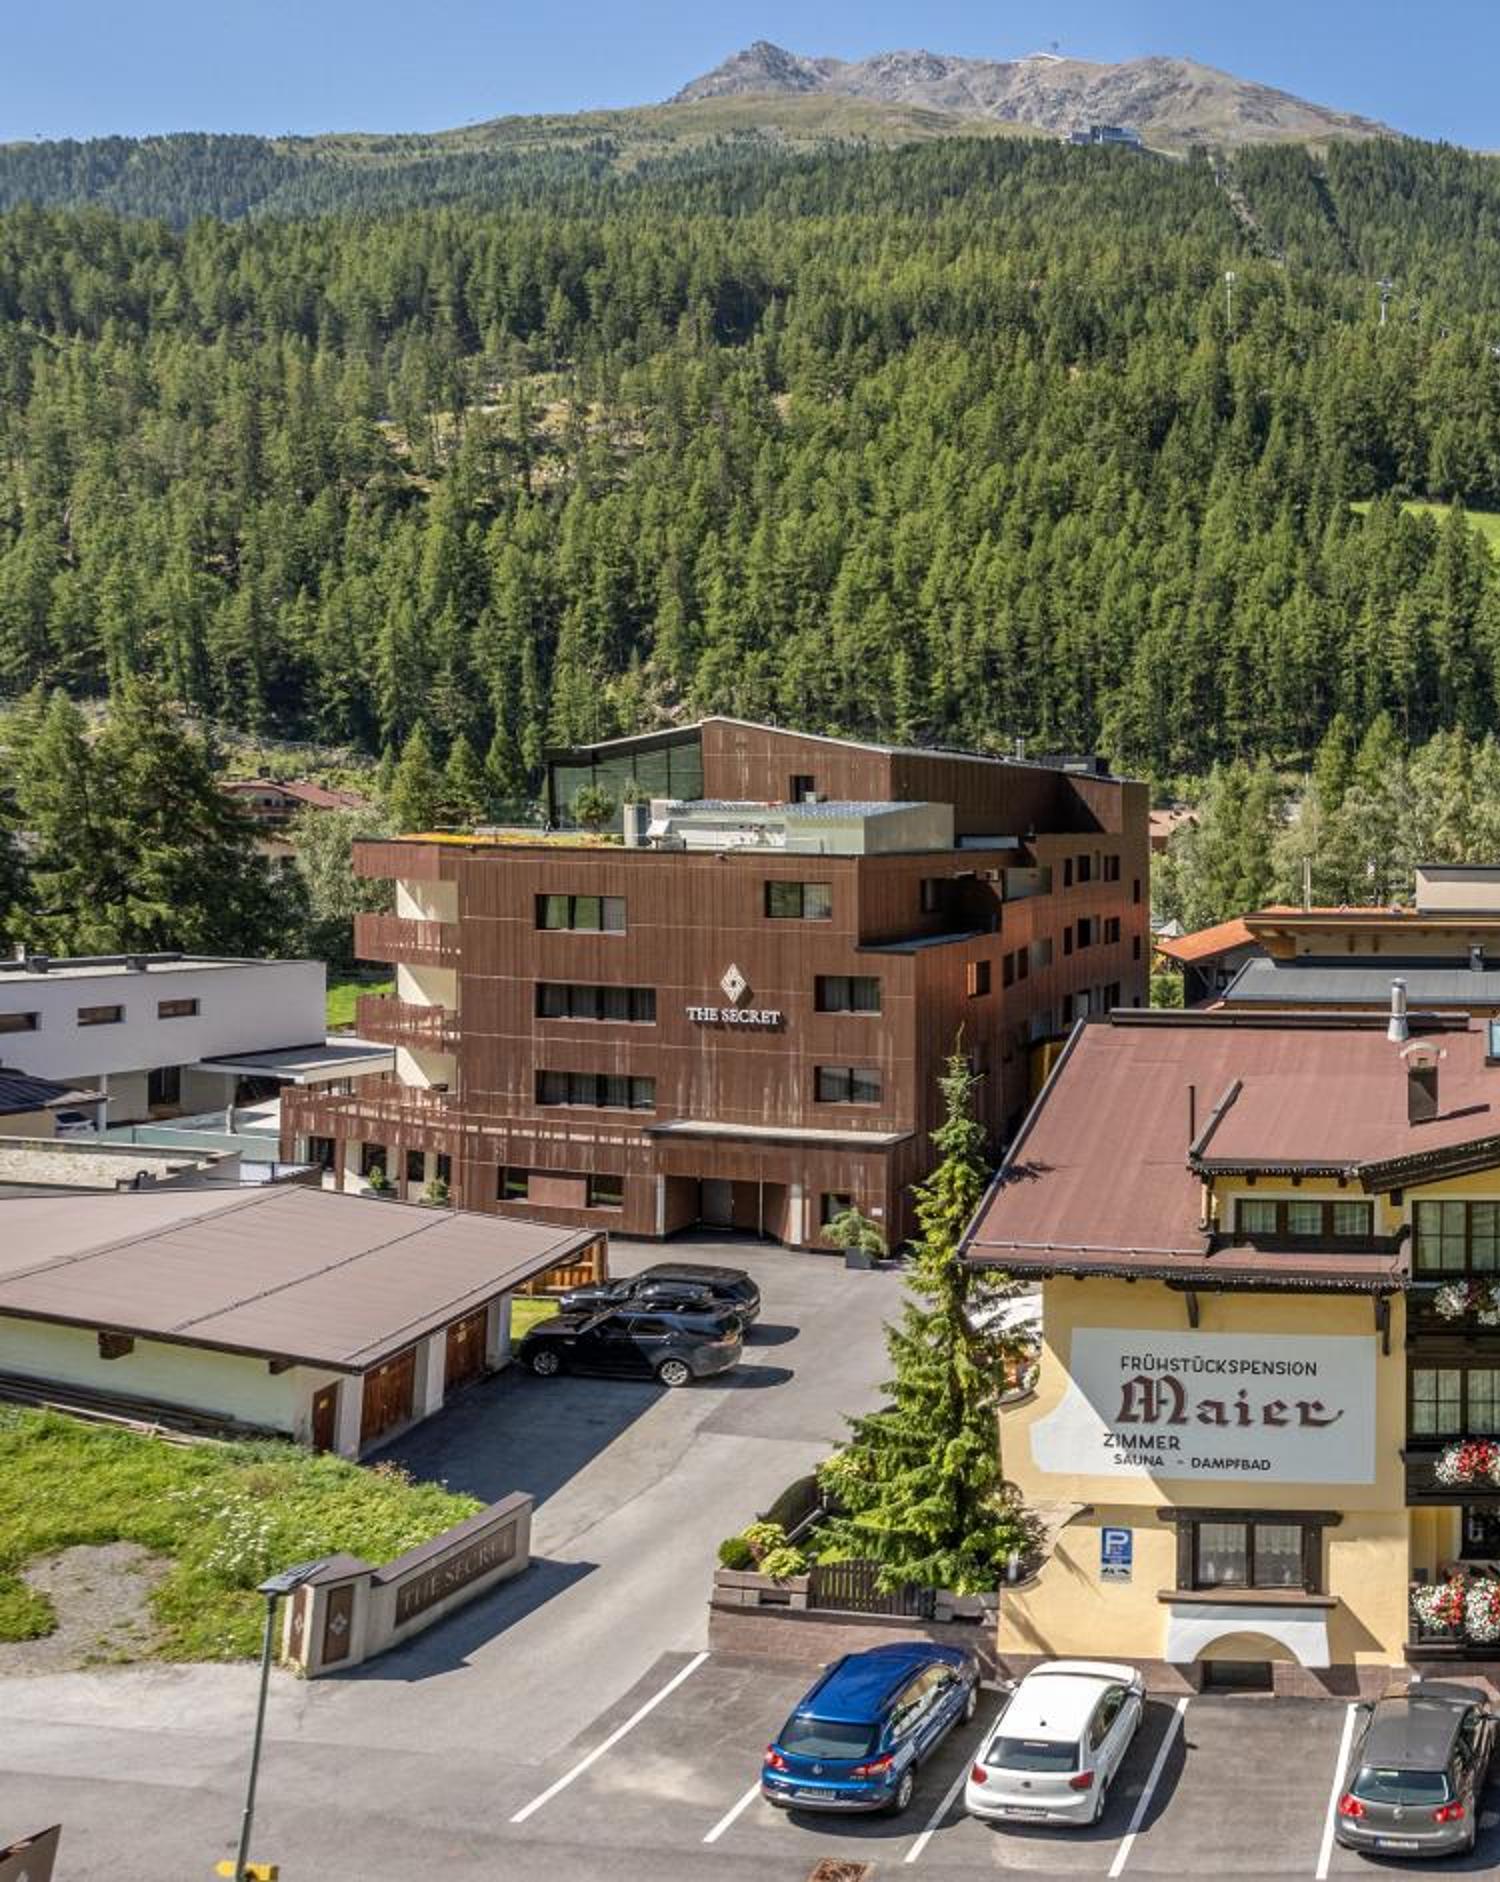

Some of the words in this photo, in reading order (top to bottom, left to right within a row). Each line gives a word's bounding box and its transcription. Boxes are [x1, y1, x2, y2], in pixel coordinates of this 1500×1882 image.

[686, 1007, 718, 1021] THE
[721, 1008, 781, 1025] SECRET
[1120, 1354, 1318, 1377] FRÜHSTÜCKSPENSION
[1115, 1374, 1344, 1427] Maier
[1103, 1433, 1181, 1451] ZIMMER
[1113, 1453, 1164, 1467] SAUNA
[1191, 1456, 1271, 1471] DAMPFBAD
[1105, 1530, 1129, 1555] P
